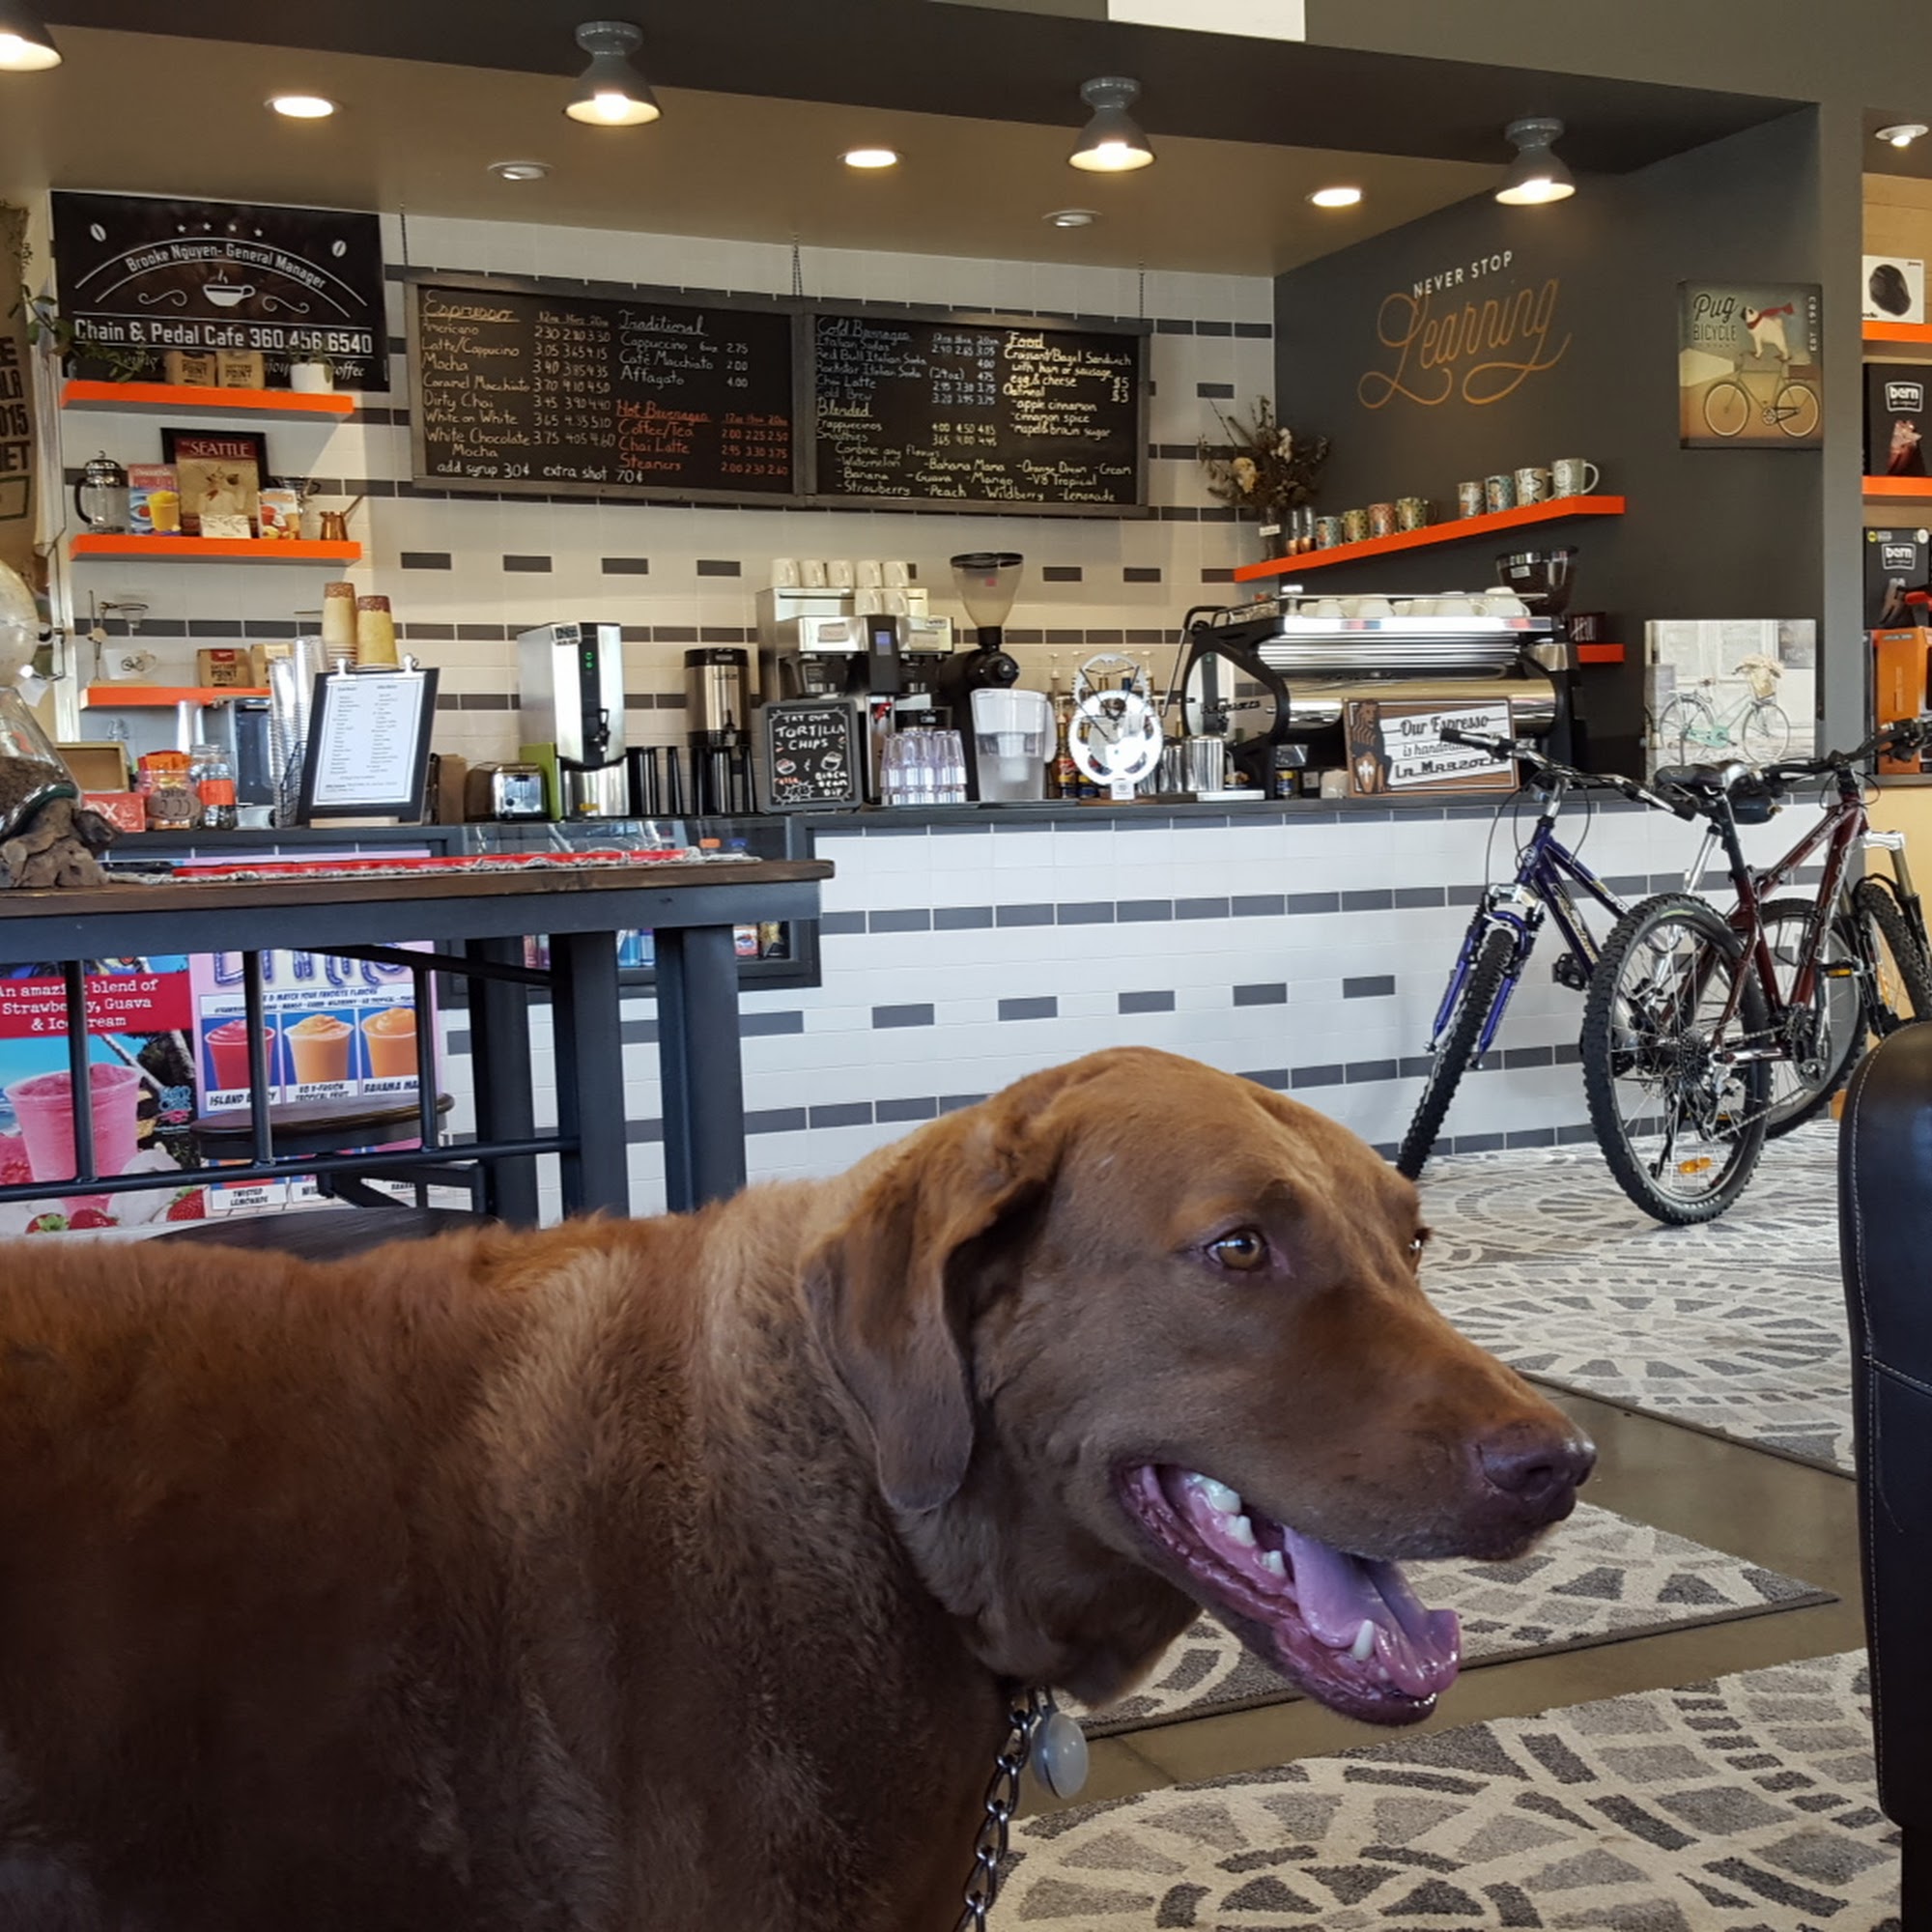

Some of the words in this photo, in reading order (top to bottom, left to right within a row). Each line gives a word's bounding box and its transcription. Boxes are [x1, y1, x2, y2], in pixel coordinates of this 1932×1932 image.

[125, 249, 169, 272] Brooke
[225, 243, 272, 266] General
[275, 254, 327, 290] Manager
[1413, 268, 1464, 299] NEVER
[1471, 250, 1513, 278] STOP
[423, 290, 520, 323] Espresso
[1693, 294, 1738, 323] Pug
[423, 316, 480, 335] Americano
[618, 308, 709, 337] Traditional
[817, 317, 849, 337] Cold
[74, 319, 124, 342] Chain
[129, 322, 145, 344] &
[151, 323, 200, 345] Pedal
[204, 327, 242, 347] Cafe
[1005, 331, 1046, 350] Food
[1693, 325, 1736, 341] BICYCLE
[1357, 278, 1573, 410] Learning
[421, 352, 469, 371] Mocha
[653, 350, 714, 369] Macchiato
[839, 349, 865, 361] Bull
[1085, 352, 1131, 366] Sandwich
[334, 359, 365, 379] offee
[1011, 360, 1034, 373] with
[1038, 361, 1059, 374] ham
[423, 371, 469, 388] Caramel
[843, 375, 877, 389] Latte
[1009, 375, 1031, 388] egg
[1042, 375, 1077, 387] cheese
[423, 389, 456, 412] Dirty
[461, 391, 494, 408] Chai
[1889, 386, 1918, 399] bern
[616, 398, 641, 418] Hot
[817, 397, 873, 417] Blended
[1016, 399, 1045, 412] apple
[1047, 398, 1097, 412] cinnamon
[423, 408, 460, 423] White
[479, 409, 519, 425] White
[1063, 412, 1091, 426] spice
[424, 426, 466, 442] White
[469, 427, 530, 446] Chocolate
[1050, 423, 1080, 435] brown
[190, 441, 249, 456] SEATTLE
[451, 442, 498, 457] Mocha
[618, 436, 652, 452] Chai
[655, 437, 692, 455] Latte
[835, 441, 879, 455] Combine
[883, 448, 901, 460] any
[437, 460, 462, 473] add
[466, 464, 497, 477] syrup
[543, 464, 578, 479] extra
[582, 466, 609, 481] shot
[841, 455, 901, 468] Watermelon
[973, 459, 1006, 471] Mama
[1022, 459, 1054, 474] Orange
[1098, 463, 1131, 475] Cream
[843, 467, 890, 480] Banana
[915, 469, 952, 483] Guava
[970, 471, 1013, 489] Mango
[1053, 473, 1097, 489] Tropical
[843, 480, 911, 497] Strawberry
[929, 484, 967, 498] Peach
[984, 485, 1044, 501] Wildberry
[1064, 488, 1115, 503] Lemonade
[1886, 547, 1913, 558] bern
[775, 724, 845, 738] TORTILLA
[1401, 719, 1428, 736] Our
[1431, 716, 1489, 732] Espresso
[788, 738, 828, 751] CHIPS
[1404, 746, 1411, 757] is
[0, 985, 16, 998] An
[93, 980, 136, 994] blend
[140, 979, 158, 991] of
[3, 1000, 101, 1014] Strawbey,
[104, 997, 152, 1010] Guava
[31, 1018, 44, 1031] &
[48, 1017, 70, 1030] Ice
[84, 1015, 127, 1029] ream
[210, 1094, 242, 1107] ISLAND
[230, 1196, 269, 1206] LEMONADE
